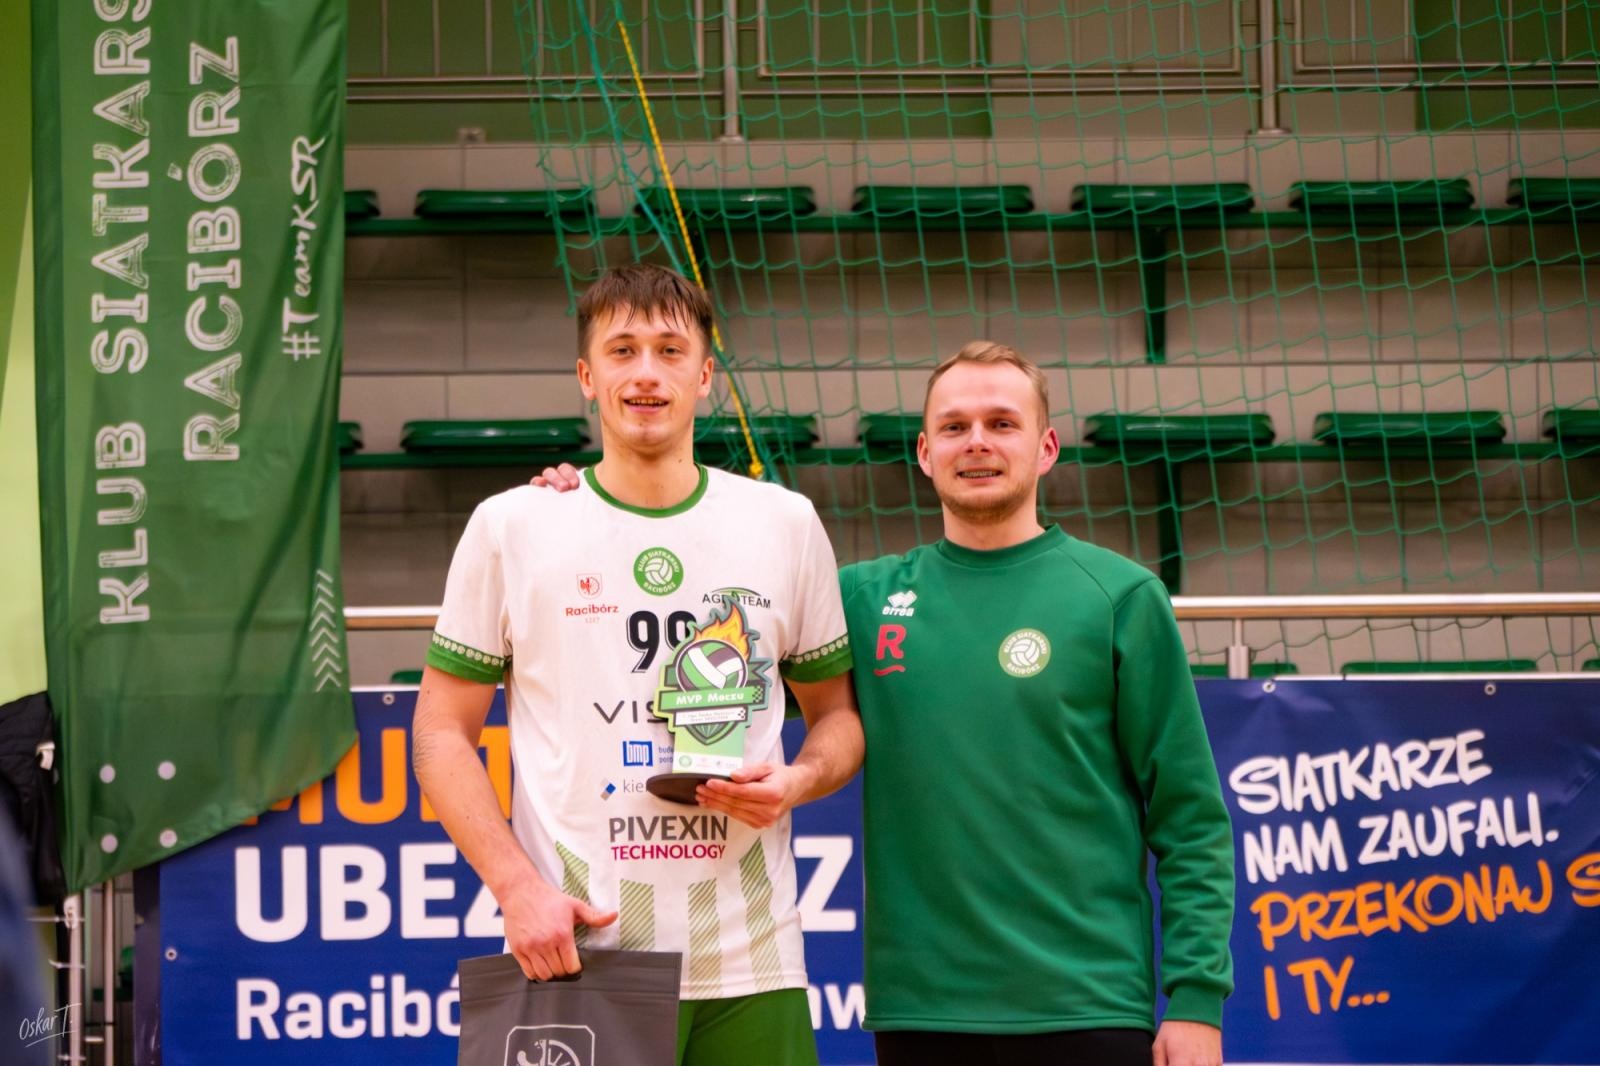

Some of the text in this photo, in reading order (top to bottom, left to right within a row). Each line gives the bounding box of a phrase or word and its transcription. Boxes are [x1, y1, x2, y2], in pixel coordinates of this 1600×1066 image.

[168, 37, 242, 460] RACIBÓRZ
[281, 135, 326, 361] #TeamKSR
[95, 422, 150, 624] KLUB
[565, 603, 619, 617] Racibórz
[876, 624, 907, 660] R
[676, 694, 703, 705] MVP
[1229, 729, 1492, 814] SIATKARZE
[608, 816, 728, 843] PIVEXIN
[611, 845, 726, 860] TECHNOLOGY
[1243, 792, 1559, 883] NAM ZAUFALI.
[1250, 859, 1552, 951] PRZEKONAJ
[1264, 965, 1281, 1020] I
